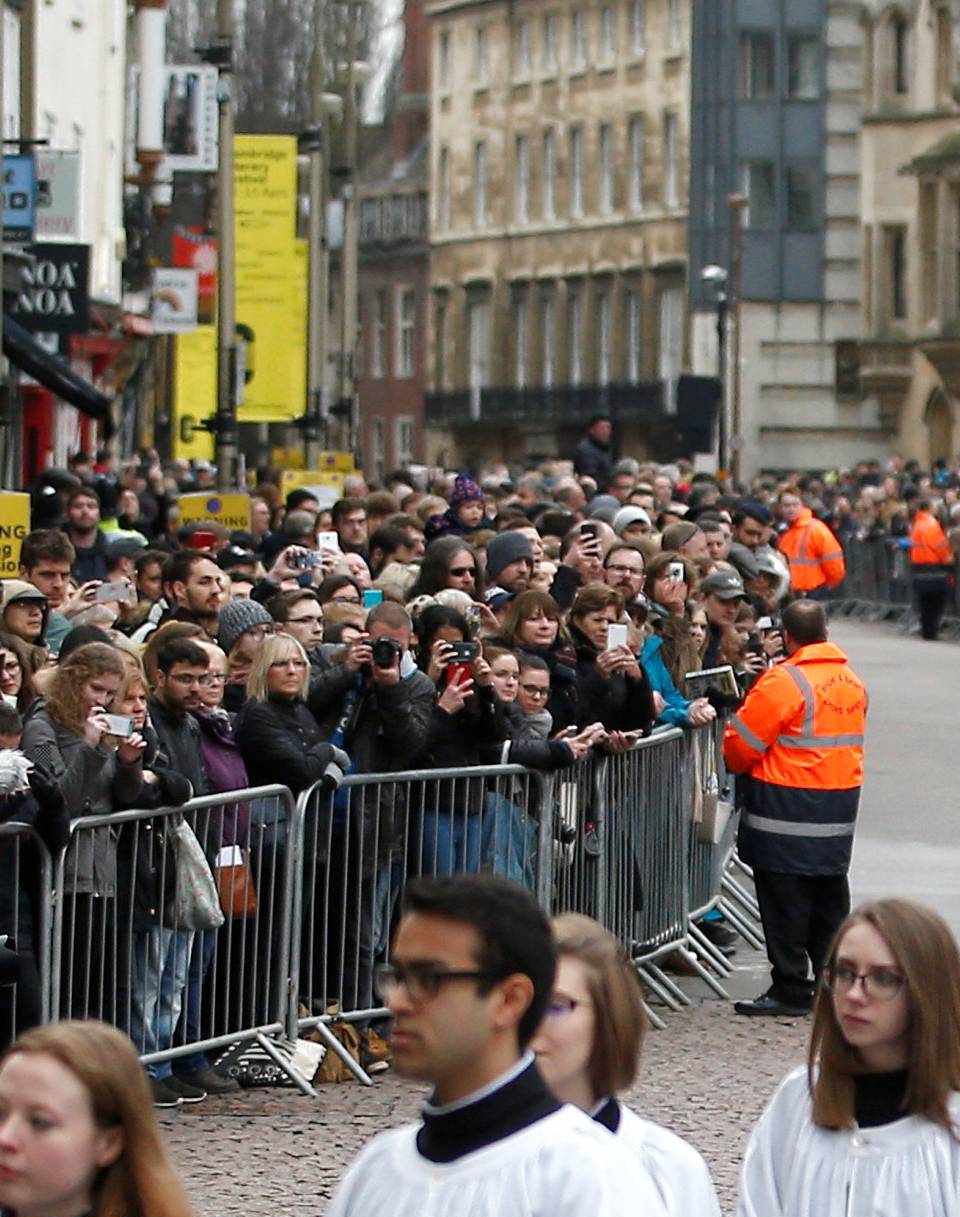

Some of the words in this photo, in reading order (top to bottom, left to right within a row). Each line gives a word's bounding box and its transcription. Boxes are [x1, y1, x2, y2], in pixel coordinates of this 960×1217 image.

[20, 261, 77, 289] NOA
[15, 289, 75, 315] NOA
[0, 526, 25, 539] NG
